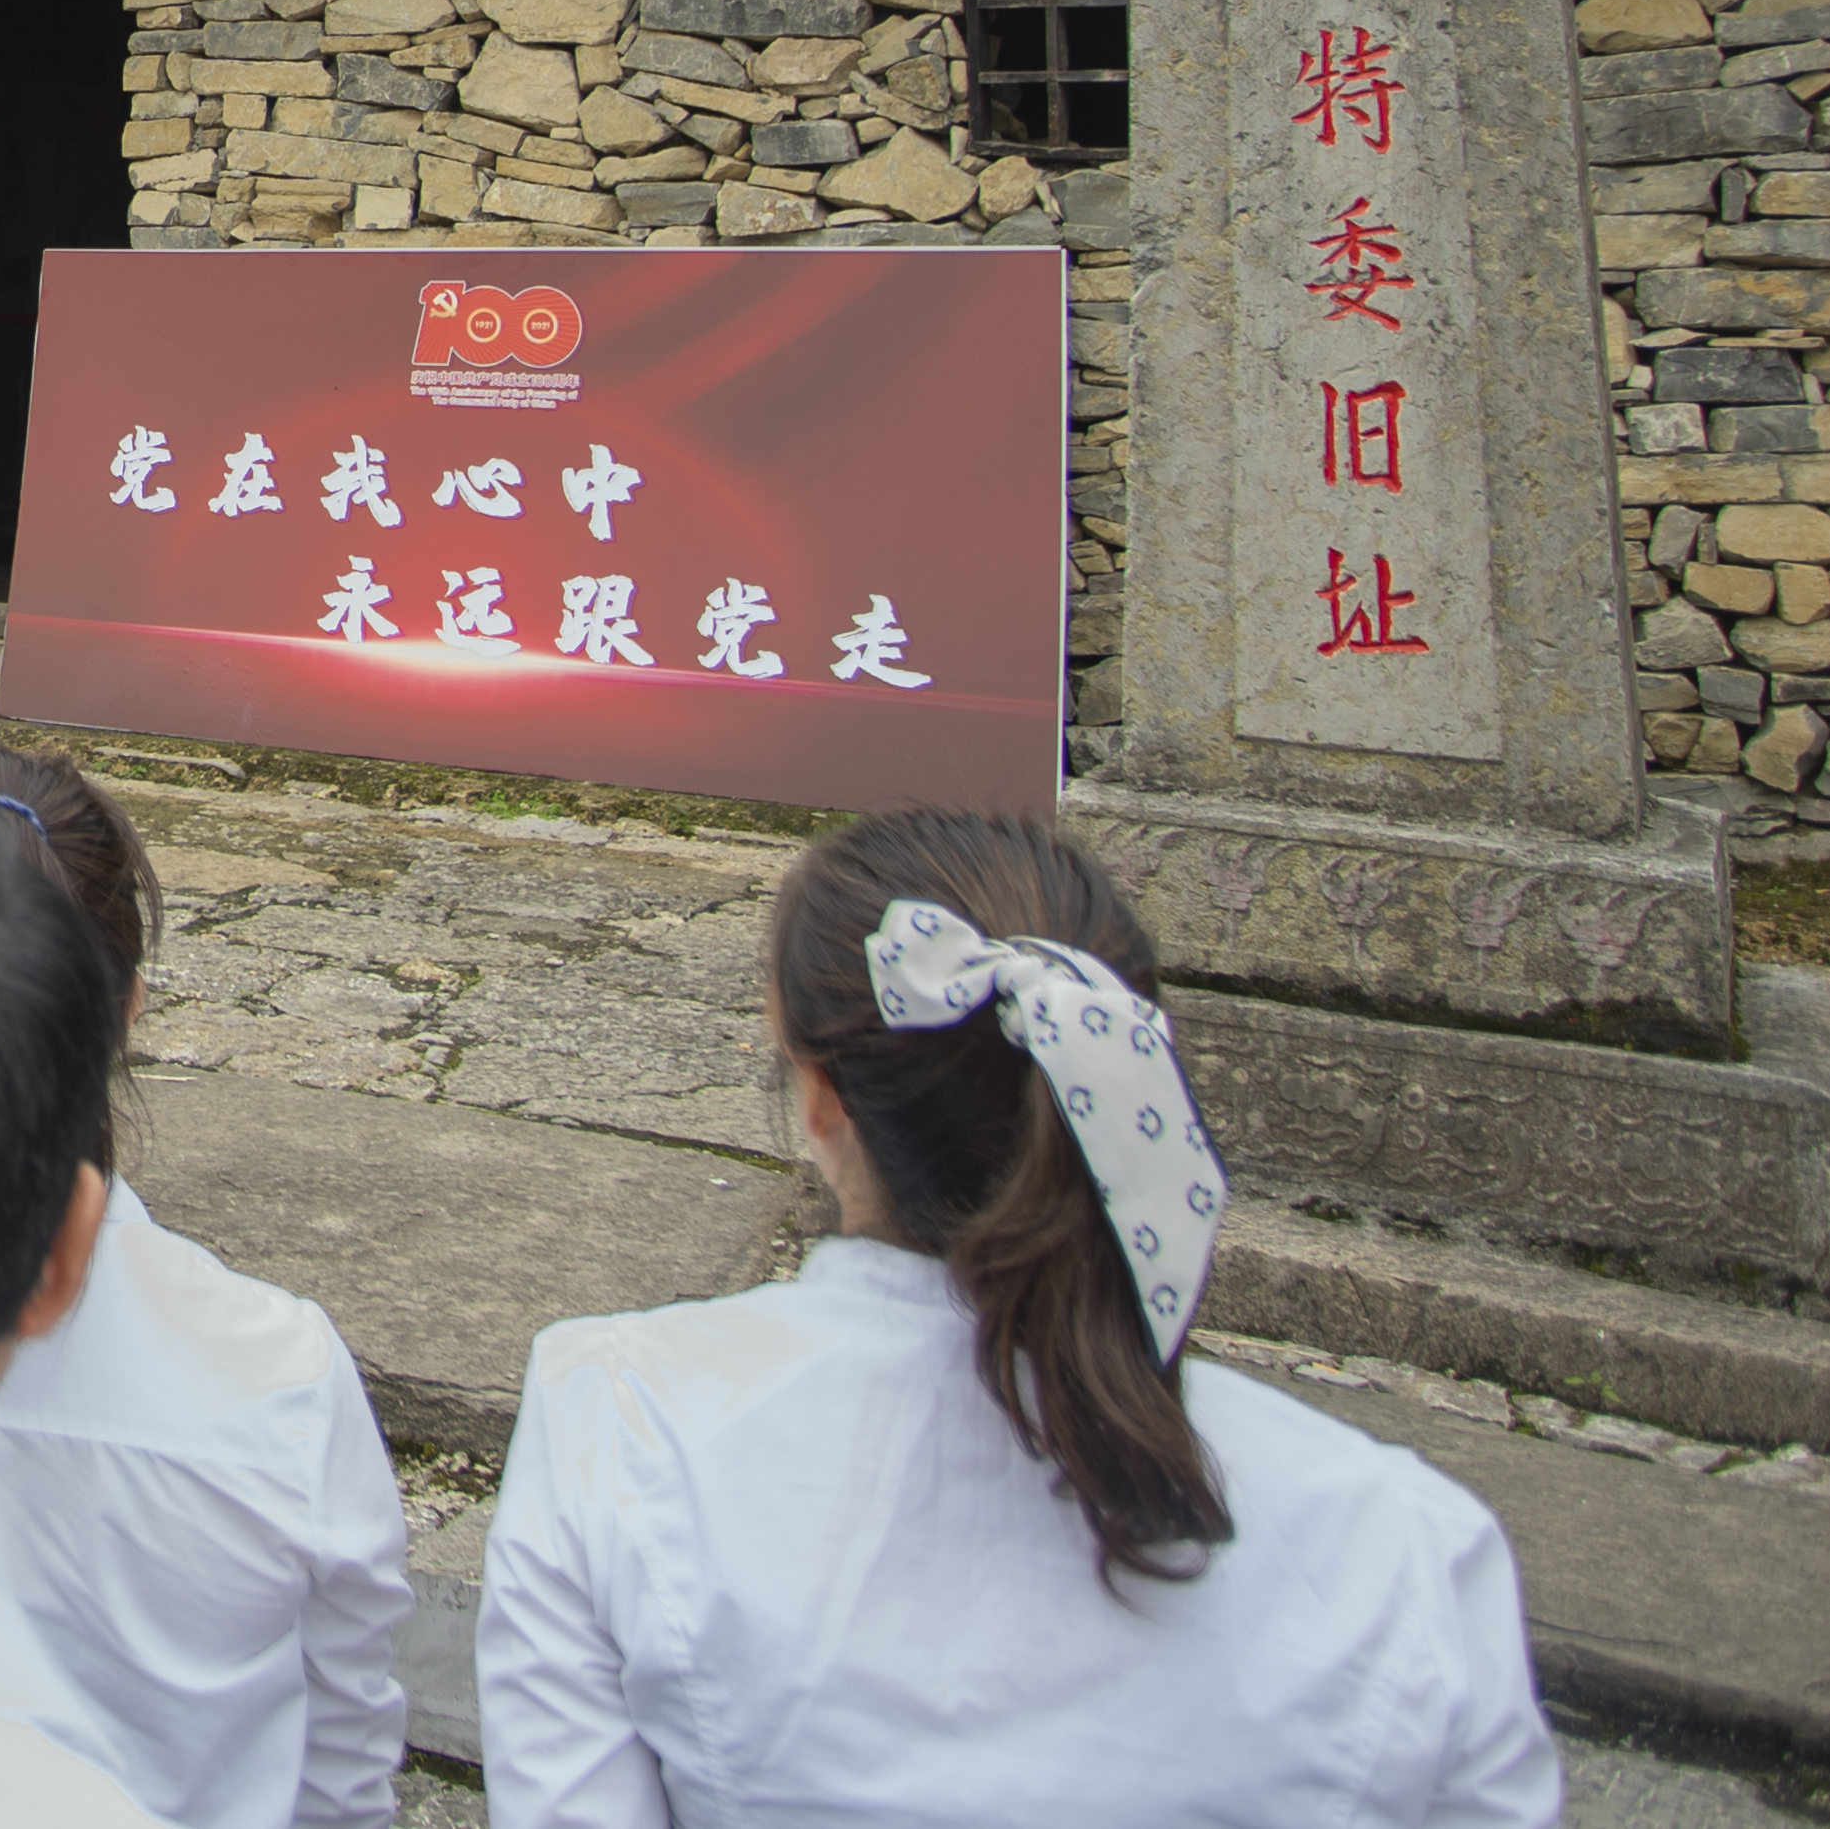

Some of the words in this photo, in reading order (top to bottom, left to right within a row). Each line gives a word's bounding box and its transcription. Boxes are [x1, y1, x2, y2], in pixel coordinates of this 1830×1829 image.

[475, 320, 494, 330] 1921
[530, 321, 551, 331] 2021
[108, 424, 643, 542] 党在我心中
[316, 554, 932, 689] 永远跟党走
